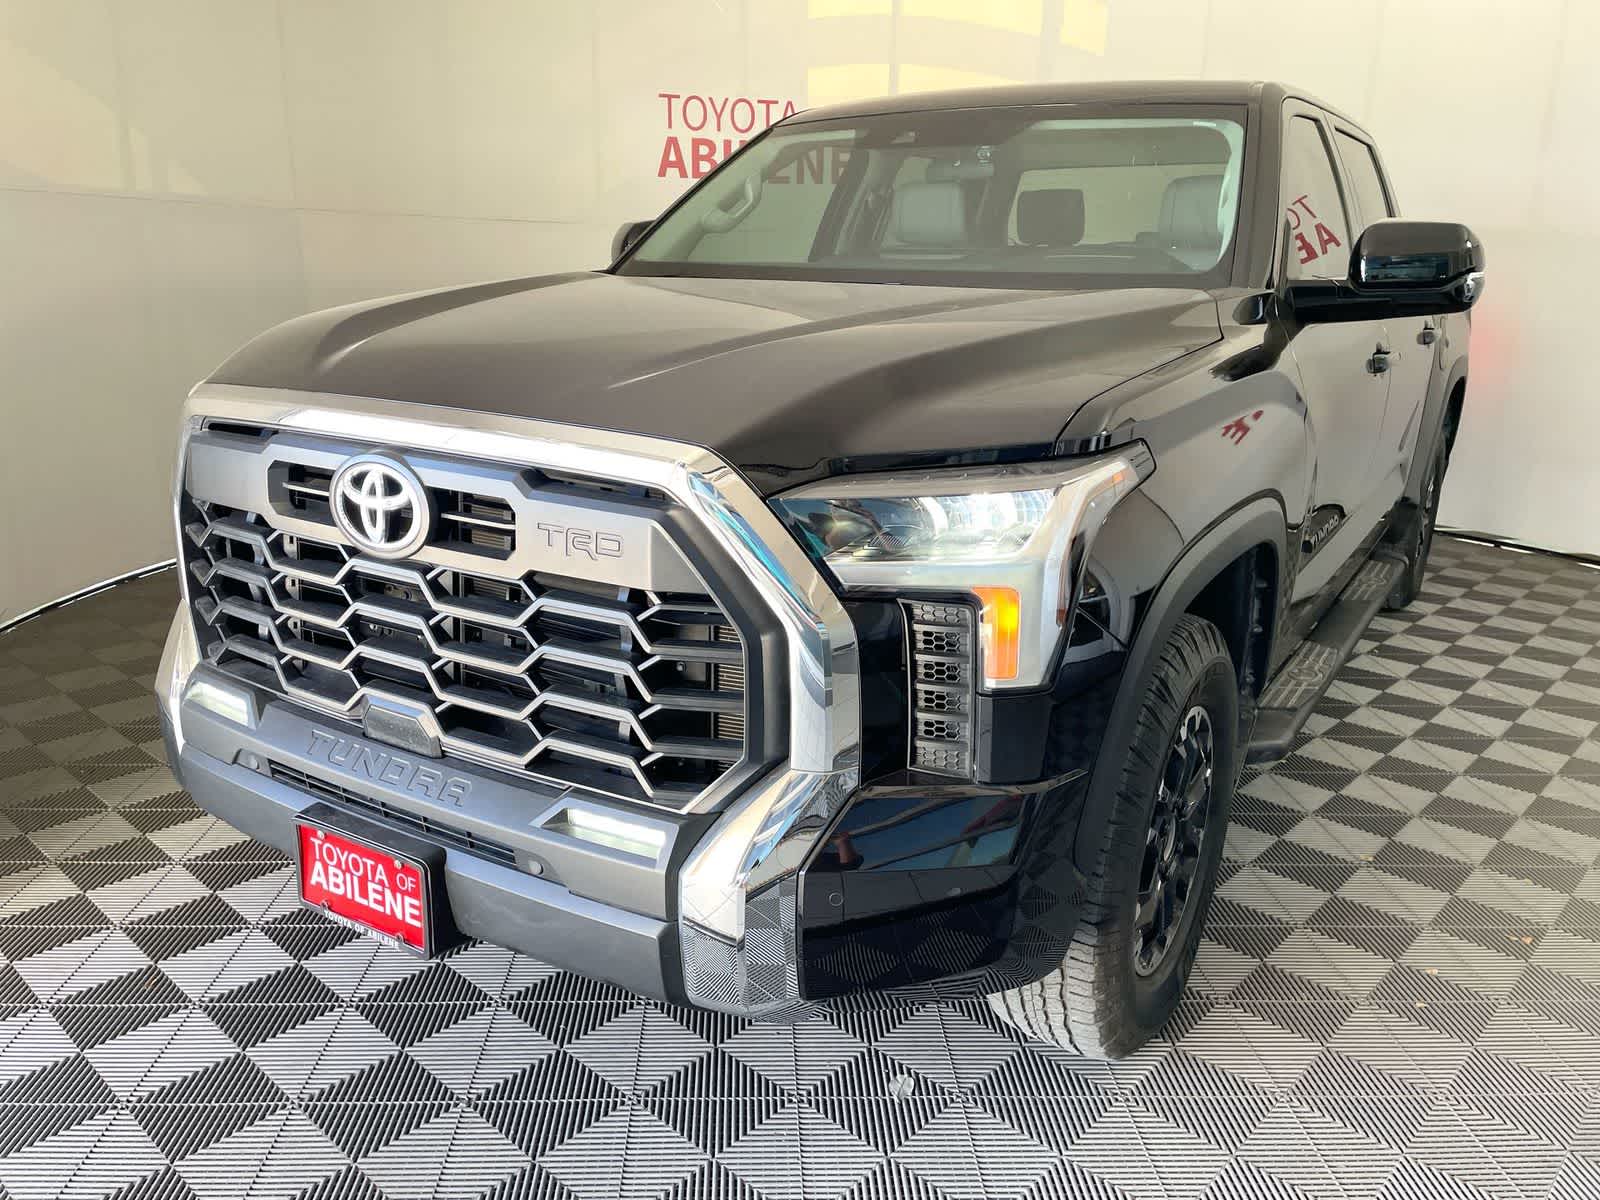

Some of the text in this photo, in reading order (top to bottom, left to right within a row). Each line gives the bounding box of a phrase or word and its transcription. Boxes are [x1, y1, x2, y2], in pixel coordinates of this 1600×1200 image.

[537, 522, 624, 560] TRD
[307, 729, 473, 807] TUNDRA
[310, 837, 416, 893] TOYOTA OF
[310, 861, 422, 928] ABILENE
[324, 910, 353, 929] TOYOTA
